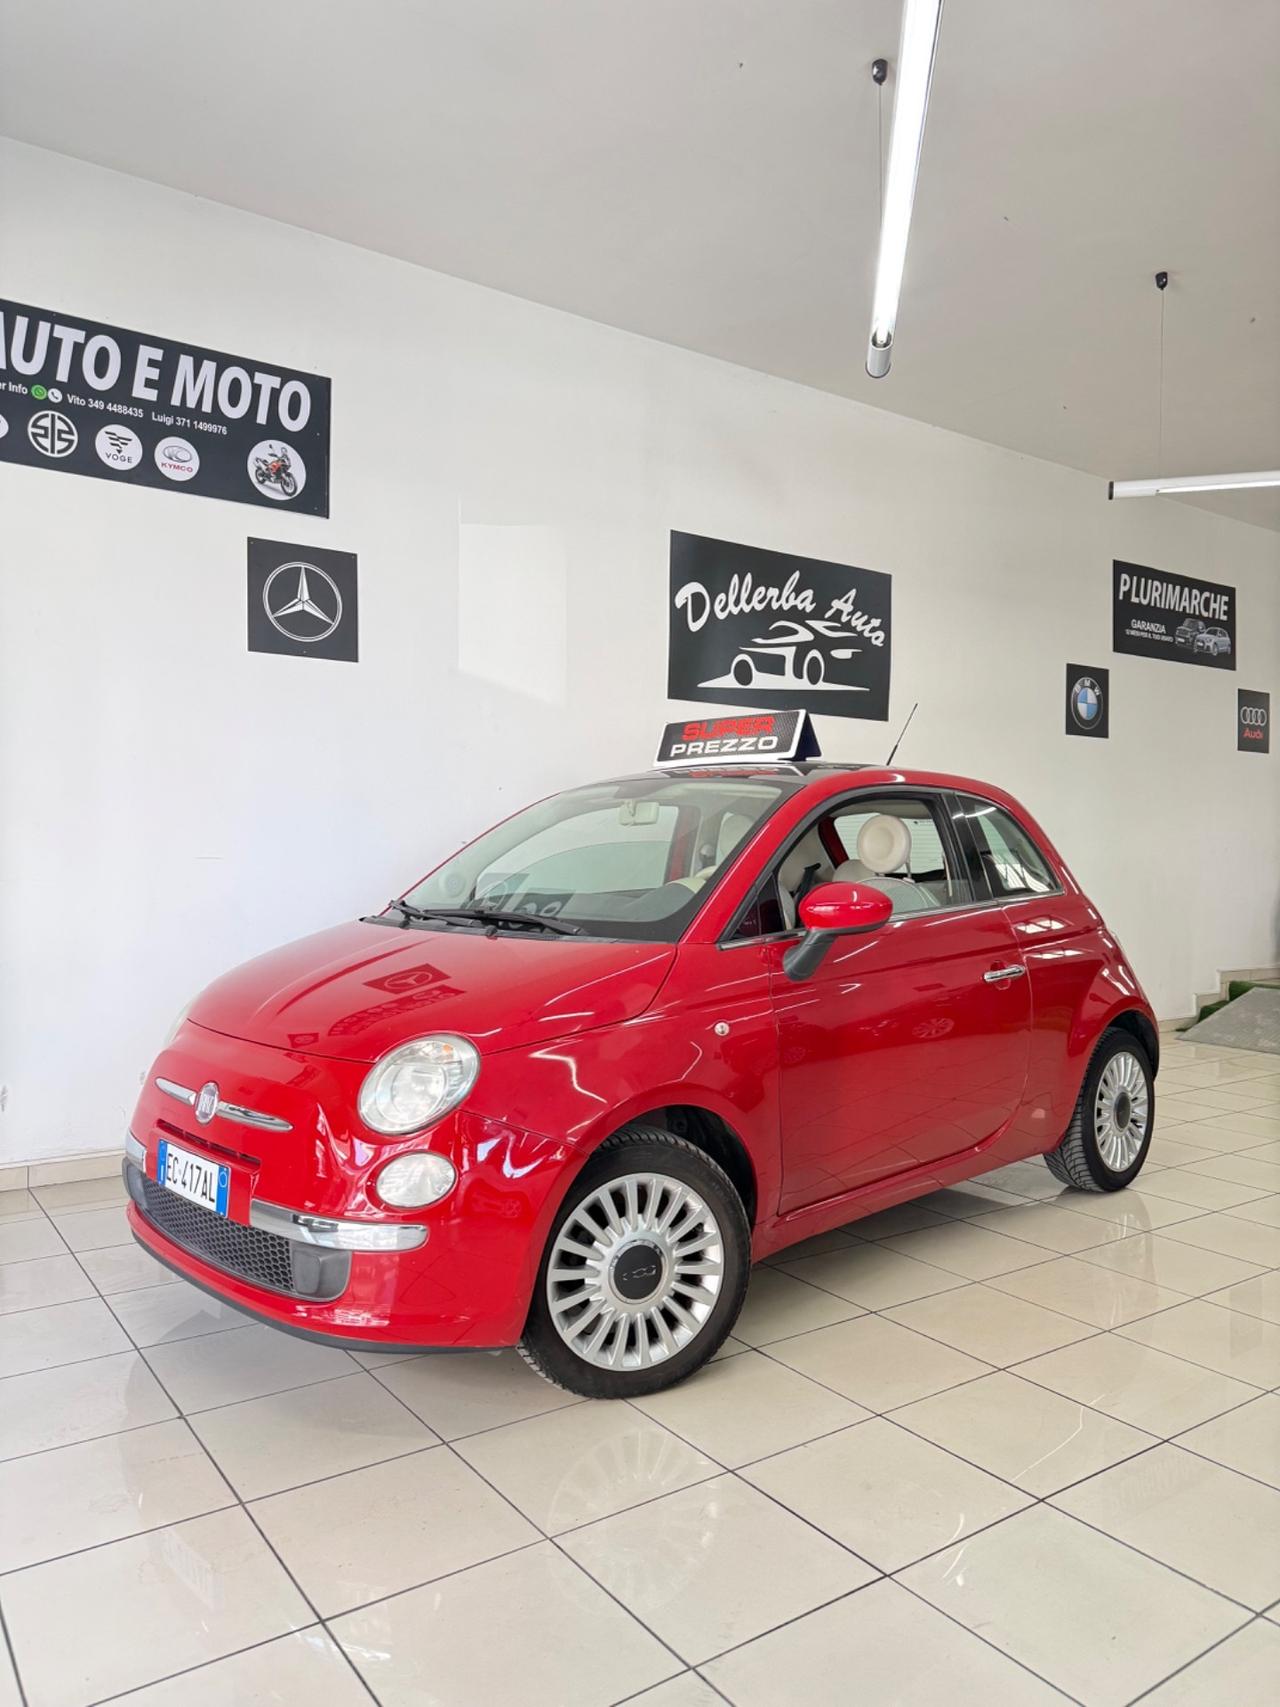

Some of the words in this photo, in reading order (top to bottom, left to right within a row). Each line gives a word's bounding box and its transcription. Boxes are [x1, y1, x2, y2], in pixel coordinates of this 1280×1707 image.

[0, 311, 121, 391] UTO
[131, 344, 165, 402] E
[170, 353, 312, 432] MOTO
[9, 382, 28, 395] Info
[66, 393, 86, 407] Vito
[88, 398, 104, 410] 349
[106, 402, 144, 418] 4488435
[152, 411, 174, 426] Luigi
[175, 416, 191, 428] 371
[193, 420, 228, 435] 1499976
[105, 452, 133, 464] VOGE
[160, 462, 194, 473] KYMCO
[674, 569, 817, 633] Dellerba
[824, 588, 886, 647] Auto
[1118, 573, 1229, 621] PLURIMARCHE
[1131, 618, 1167, 634] GARANZIA
[681, 715, 777, 742] SUPER
[1242, 727, 1264, 739] Audi
[669, 735, 779, 758] PREZZO
[166, 1152, 179, 1185] EC
[181, 1160, 216, 1203] 417AL
